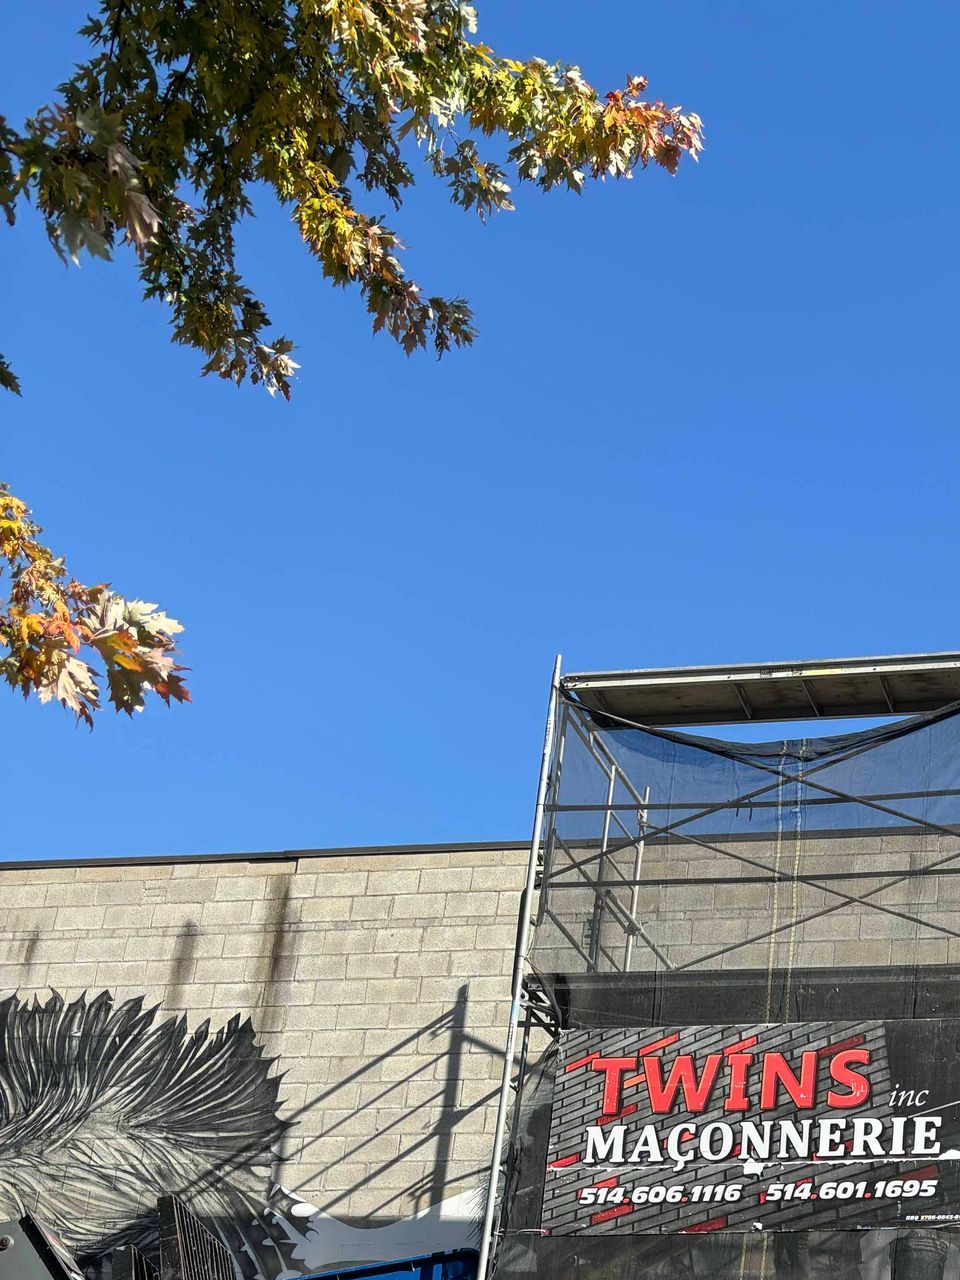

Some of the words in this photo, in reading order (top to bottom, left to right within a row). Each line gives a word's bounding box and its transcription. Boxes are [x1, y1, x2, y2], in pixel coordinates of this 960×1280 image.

[591, 1049, 870, 1115] TWINS
[888, 1083, 929, 1108] inc
[582, 1116, 943, 1172] MAÇONNERIE
[578, 1183, 742, 1206] 514.606.1116
[765, 1179, 938, 1201] 514.601.1695
